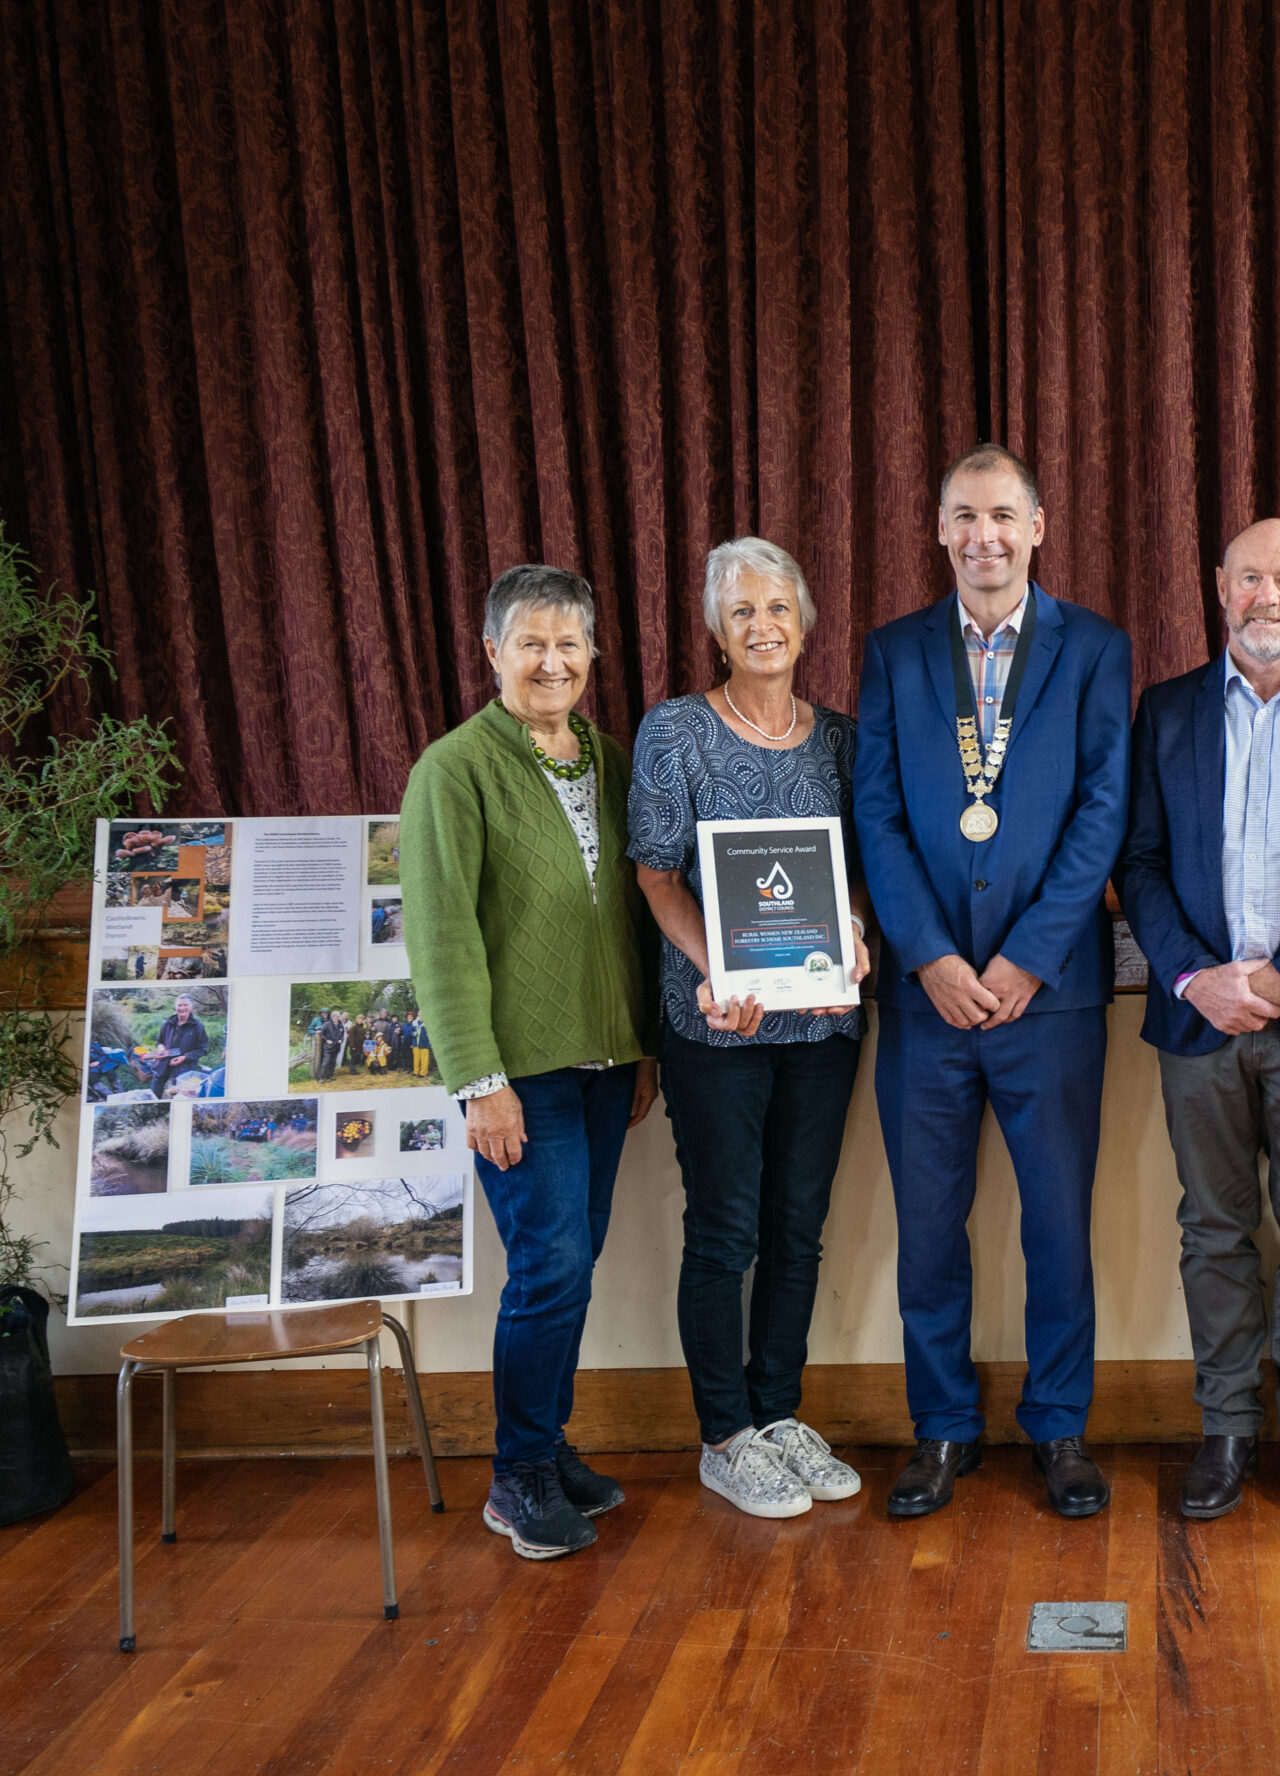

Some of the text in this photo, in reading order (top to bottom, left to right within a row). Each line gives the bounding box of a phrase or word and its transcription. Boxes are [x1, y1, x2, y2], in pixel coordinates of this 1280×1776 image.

[727, 845, 816, 856] Community Service Award
